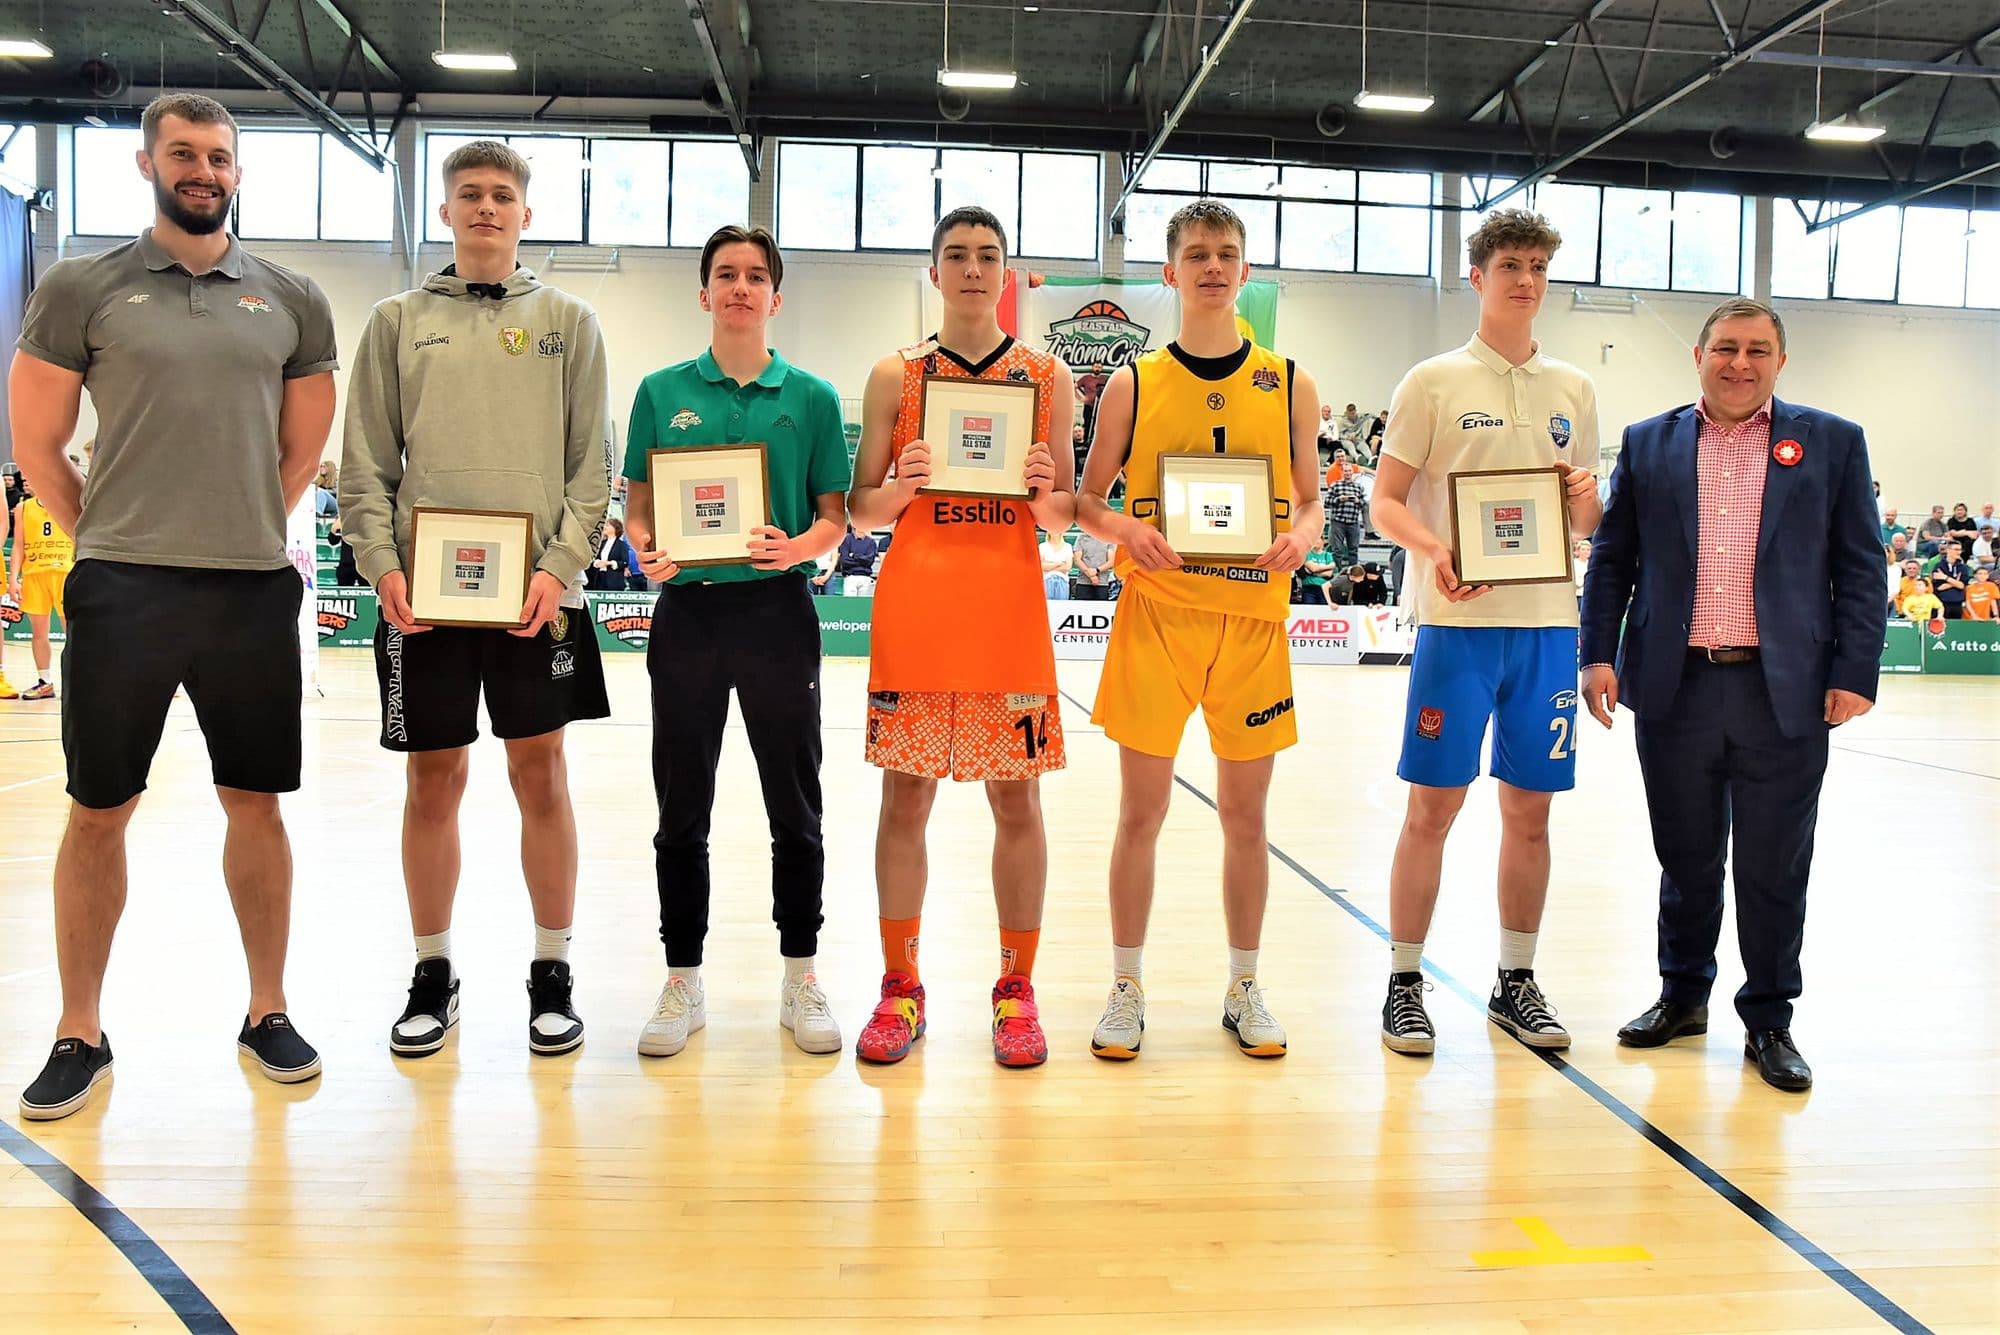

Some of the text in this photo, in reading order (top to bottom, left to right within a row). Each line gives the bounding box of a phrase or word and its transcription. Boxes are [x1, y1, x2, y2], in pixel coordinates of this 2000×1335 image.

[1080, 320, 1122, 333] ZASTAL
[415, 336, 450, 350] SPALDING
[1462, 419, 1504, 430] Enea
[962, 439, 991, 449] ALL STAR
[1212, 426, 1226, 453] 1
[696, 509, 707, 517] ALL
[934, 500, 1016, 525] Esstilo
[43, 521, 52, 536] 8
[1507, 529, 1523, 537] STAR
[455, 570, 485, 579] ALL STAR
[1183, 565, 1266, 582] GRUPA ORLEN
[1058, 615, 1114, 630] ALD
[1288, 619, 1350, 634] MED
[1288, 639, 1348, 648] EDYCZNE
[1950, 640, 1987, 651] fatto
[1015, 712, 1047, 759] 14
